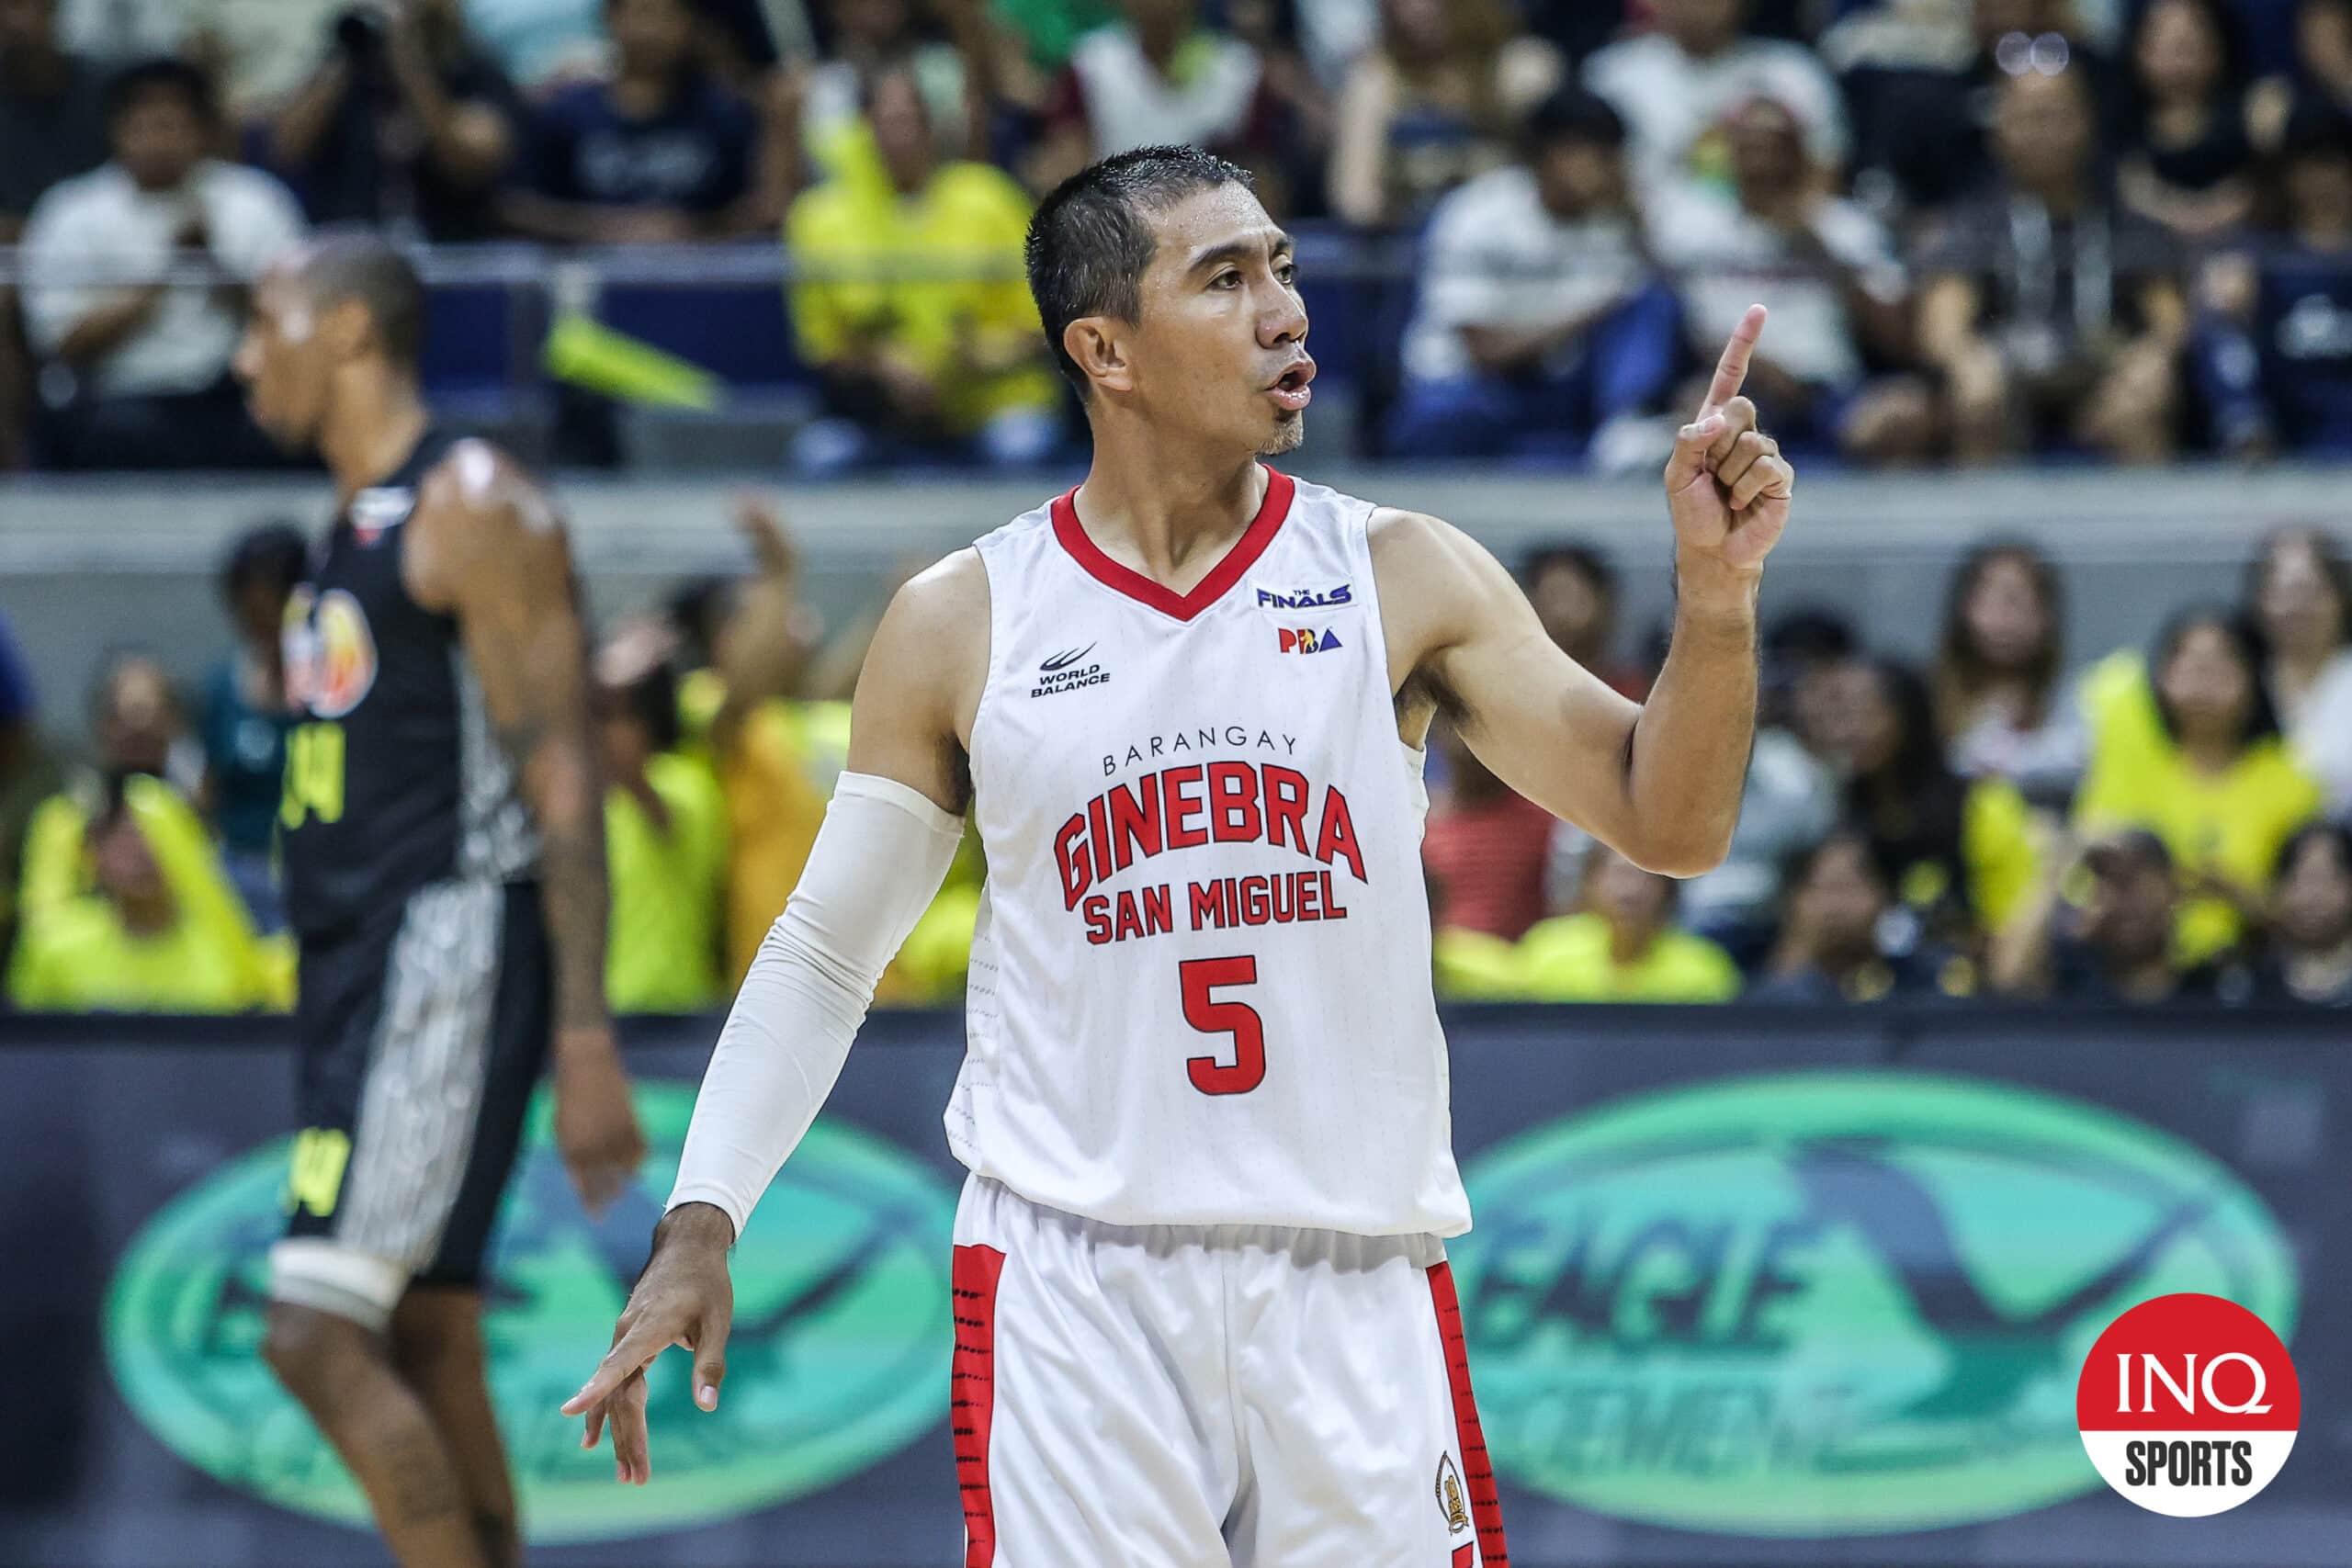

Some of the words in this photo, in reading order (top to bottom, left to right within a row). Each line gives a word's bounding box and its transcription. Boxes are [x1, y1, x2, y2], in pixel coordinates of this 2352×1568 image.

[1256, 583, 1351, 609] FINALS
[1277, 627, 1343, 655] PBA
[1030, 672, 1111, 699] BALANCE
[1039, 663, 1101, 686] WORLD
[1102, 726, 1296, 777] BARANGAY
[1054, 761, 1369, 912] GINEBRA
[1082, 883, 1174, 945] SAN
[1187, 869, 1348, 932] MIGUEL
[1179, 954, 1266, 1096] 5
[1468, 1220, 1817, 1350] EAGLE
